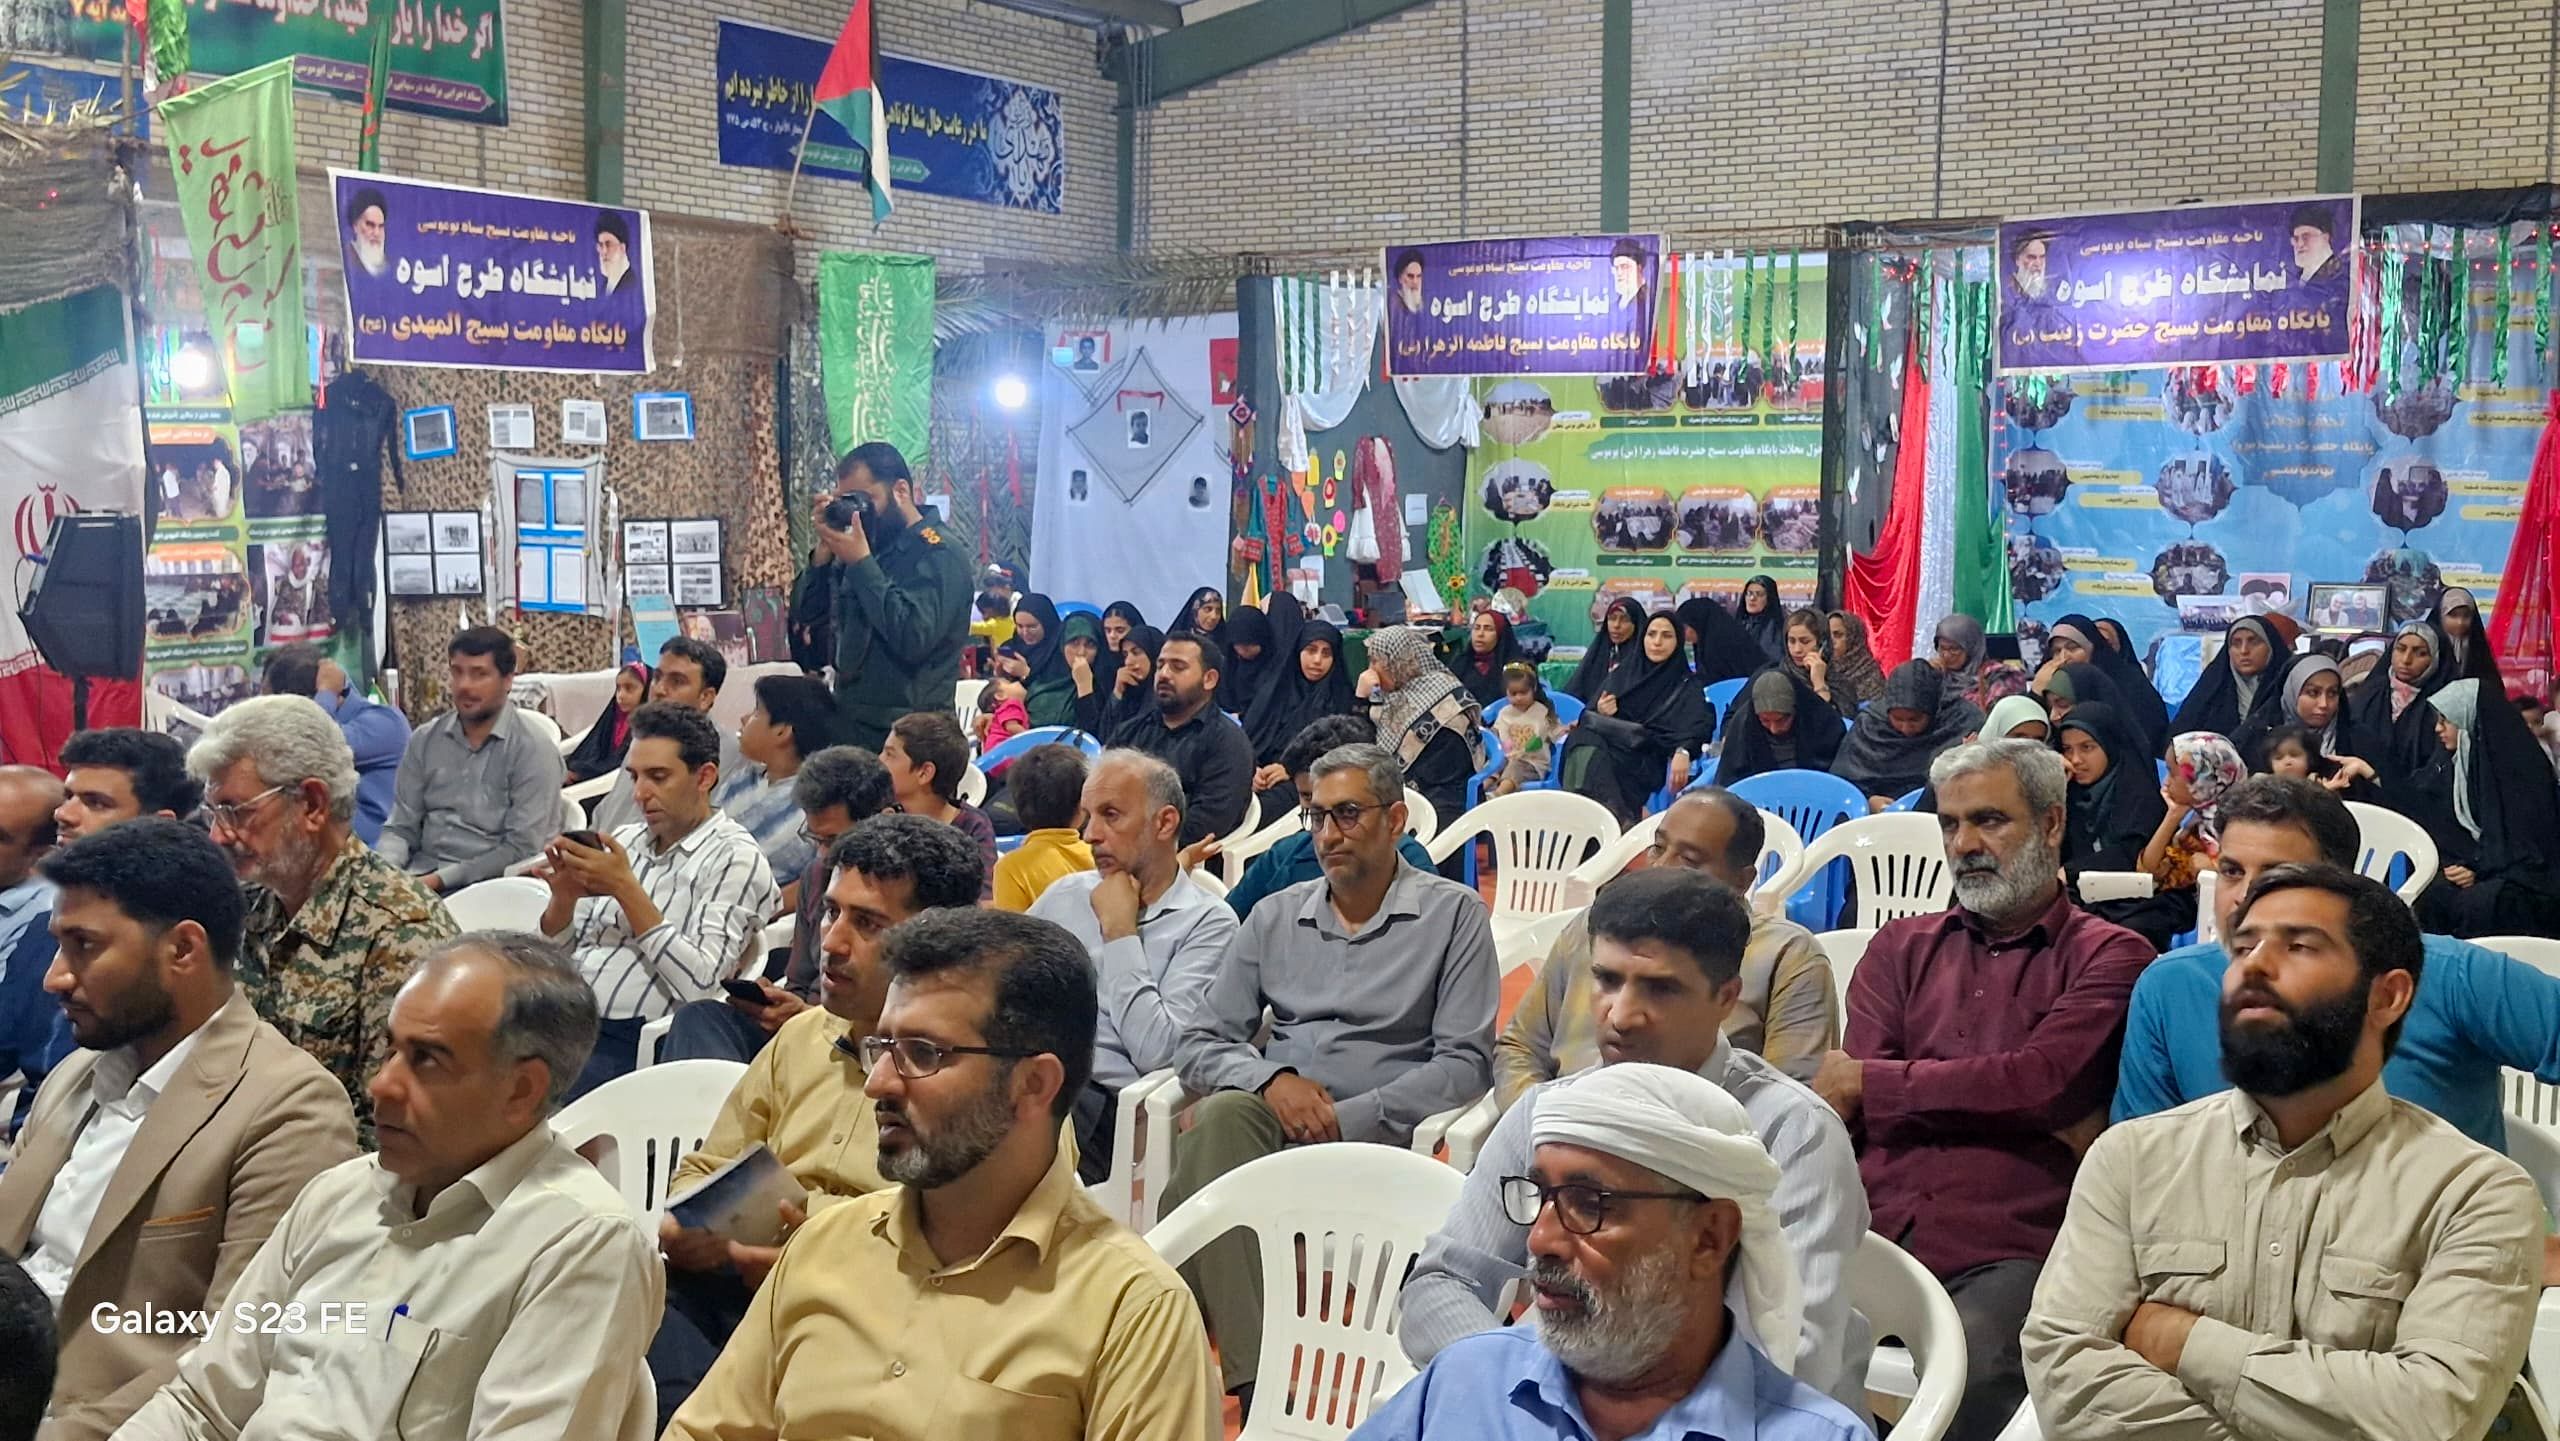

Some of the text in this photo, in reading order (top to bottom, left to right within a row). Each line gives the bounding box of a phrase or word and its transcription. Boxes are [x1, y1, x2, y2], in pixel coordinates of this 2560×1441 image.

[391, 0, 415, 45] یار
[416, 0, 433, 51] را
[435, 3, 469, 44] خدا
[471, 13, 494, 60] اگر
[765, 75, 789, 110] خاطر
[911, 103, 926, 129] شما
[926, 107, 943, 138] حال
[943, 111, 967, 145] رعایت
[979, 117, 988, 140] ما
[485, 222, 511, 240] بسیج
[512, 225, 549, 244] مقاومت
[550, 229, 577, 244] ناحیه
[2154, 236, 2184, 252] بسیج
[2185, 230, 2230, 250] مقاومت
[2231, 229, 2264, 245] ناحیه
[396, 253, 597, 305] نمایشگاه طرح اسوه
[1530, 258, 1565, 275] مقاومت
[2055, 260, 2288, 309] نمایشگاه طرح اسوه
[1429, 285, 1610, 324] نمایشگاه طرح اسوه
[391, 310, 462, 343] المهدی
[465, 318, 510, 346] بسیج
[513, 316, 577, 350] مقاومت
[580, 317, 628, 350] پایگاه
[2038, 321, 2084, 348] زینب
[2087, 316, 2150, 347] حضرت
[2154, 316, 2200, 344] بسیج
[2203, 312, 2272, 341] مقاومت
[2277, 309, 2332, 336] پایگاه
[1424, 333, 1464, 359] الزهرا
[1466, 332, 1507, 352] فاطمه
[1509, 334, 1544, 357] بسیج
[1546, 331, 1599, 356] مقاومت
[1600, 330, 1642, 353] پایگاه
[1680, 445, 1707, 459] حضرت
[1727, 443, 1756, 459] مقاومت
